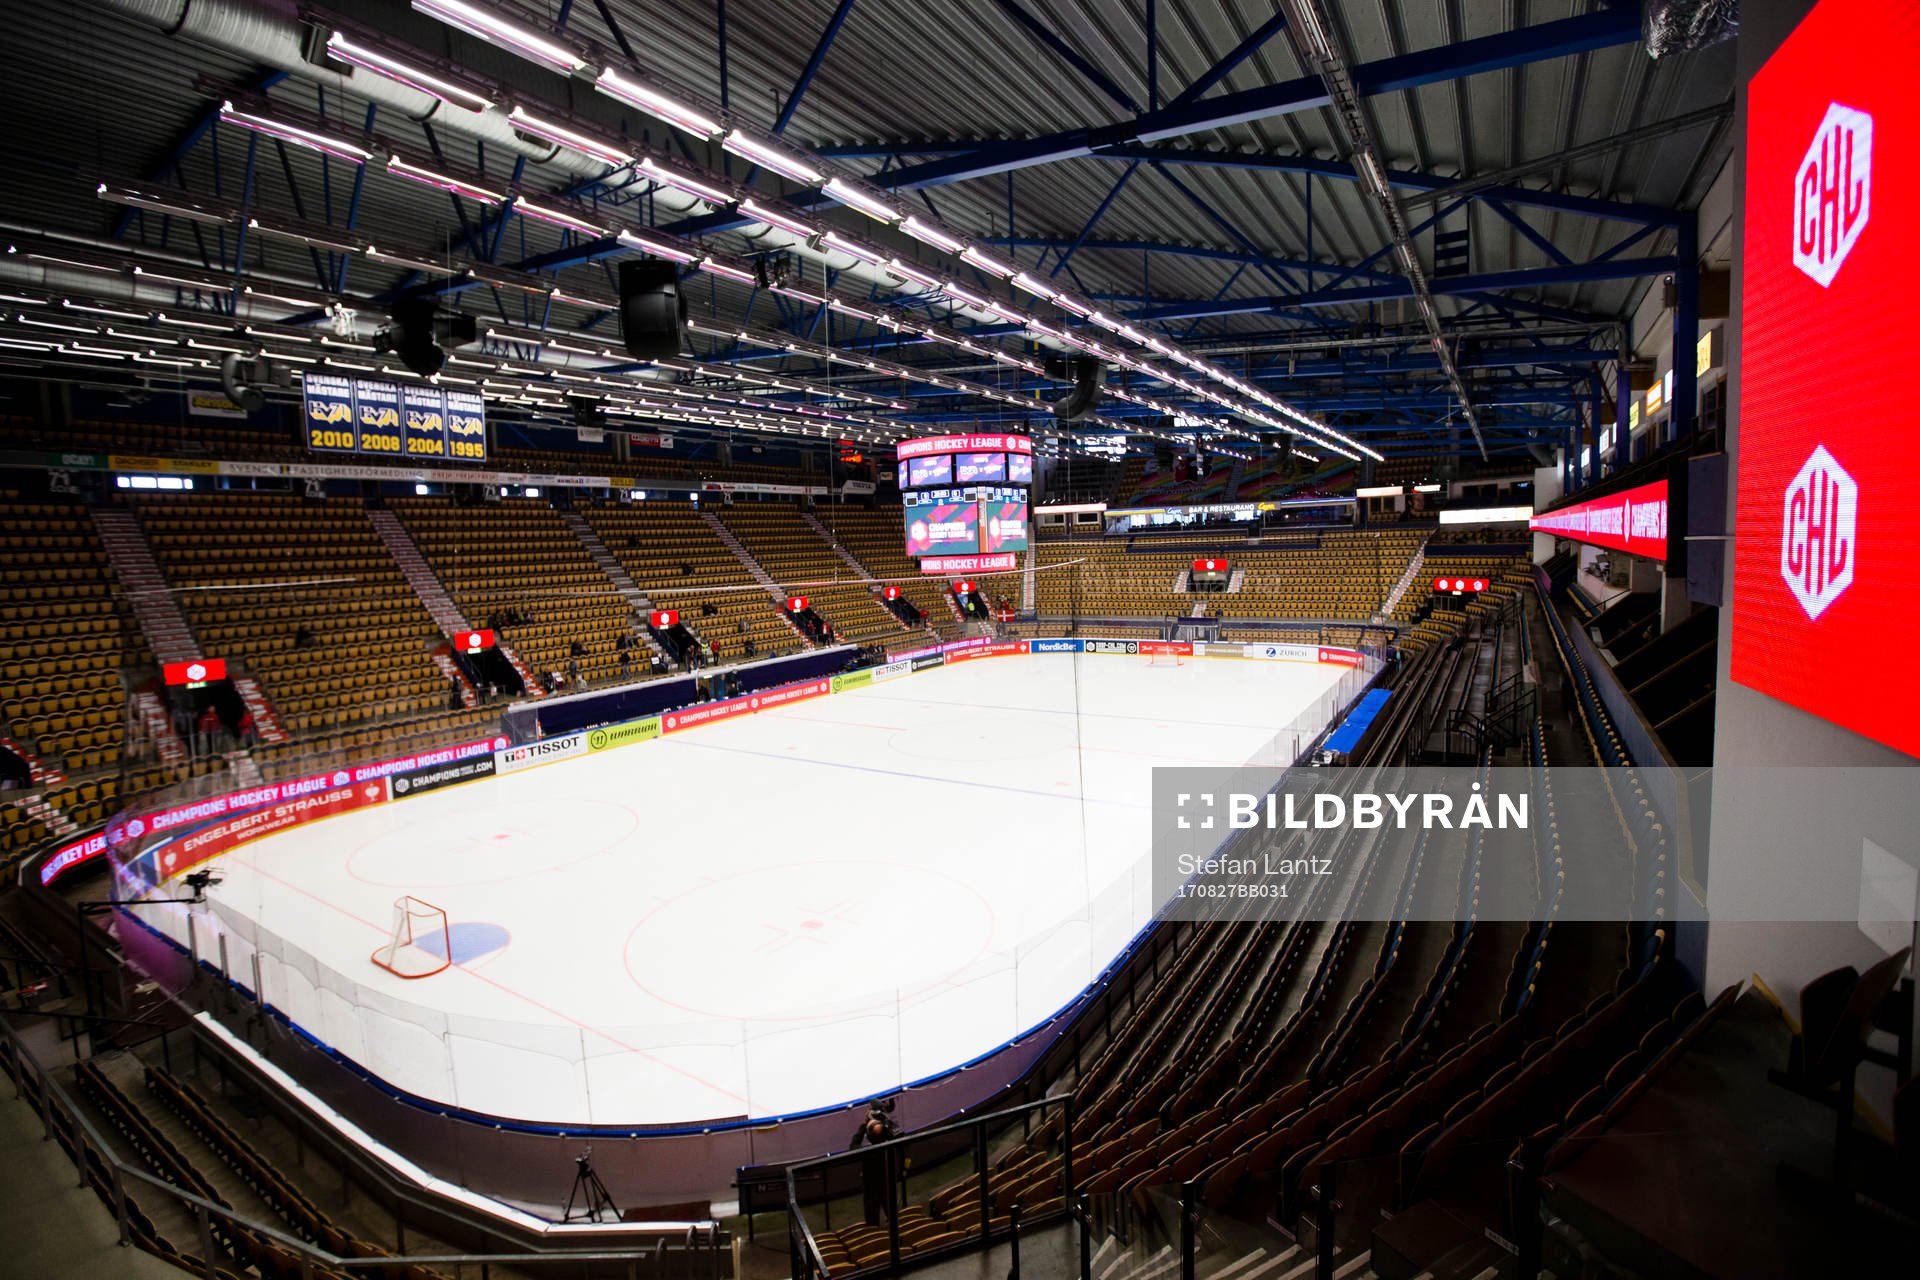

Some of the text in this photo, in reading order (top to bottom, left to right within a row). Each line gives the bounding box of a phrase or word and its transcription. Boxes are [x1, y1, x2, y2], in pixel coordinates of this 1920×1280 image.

[311, 430, 354, 448] 2010
[361, 434, 400, 451] 2008
[408, 438, 443, 454] 2004
[934, 439, 968, 451] HOCKEY
[970, 438, 1002, 448] LEAGUE
[450, 441, 484, 457] 1995
[293, 466, 423, 478] FASTIGHETSFÖRMEDLING
[943, 559, 978, 570] HOCKEY
[980, 557, 1008, 568] LEAGUE
[885, 662, 908, 673] TISSOT
[680, 702, 748, 725] CHAMPIONS HOCKEY LEAGUE
[526, 736, 579, 757] TISSOT
[356, 758, 415, 781] CHAMPIONS
[417, 751, 455, 767] HOCKEY
[456, 743, 489, 759] LEAGUE
[412, 768, 460, 787] CHAMPIONS
[153, 779, 327, 829] CHAMPIONS HOCKEY LEAGUE
[184, 789, 353, 851] ENGELBERT STRAUSS
[236, 816, 296, 840] WORKWEAR
